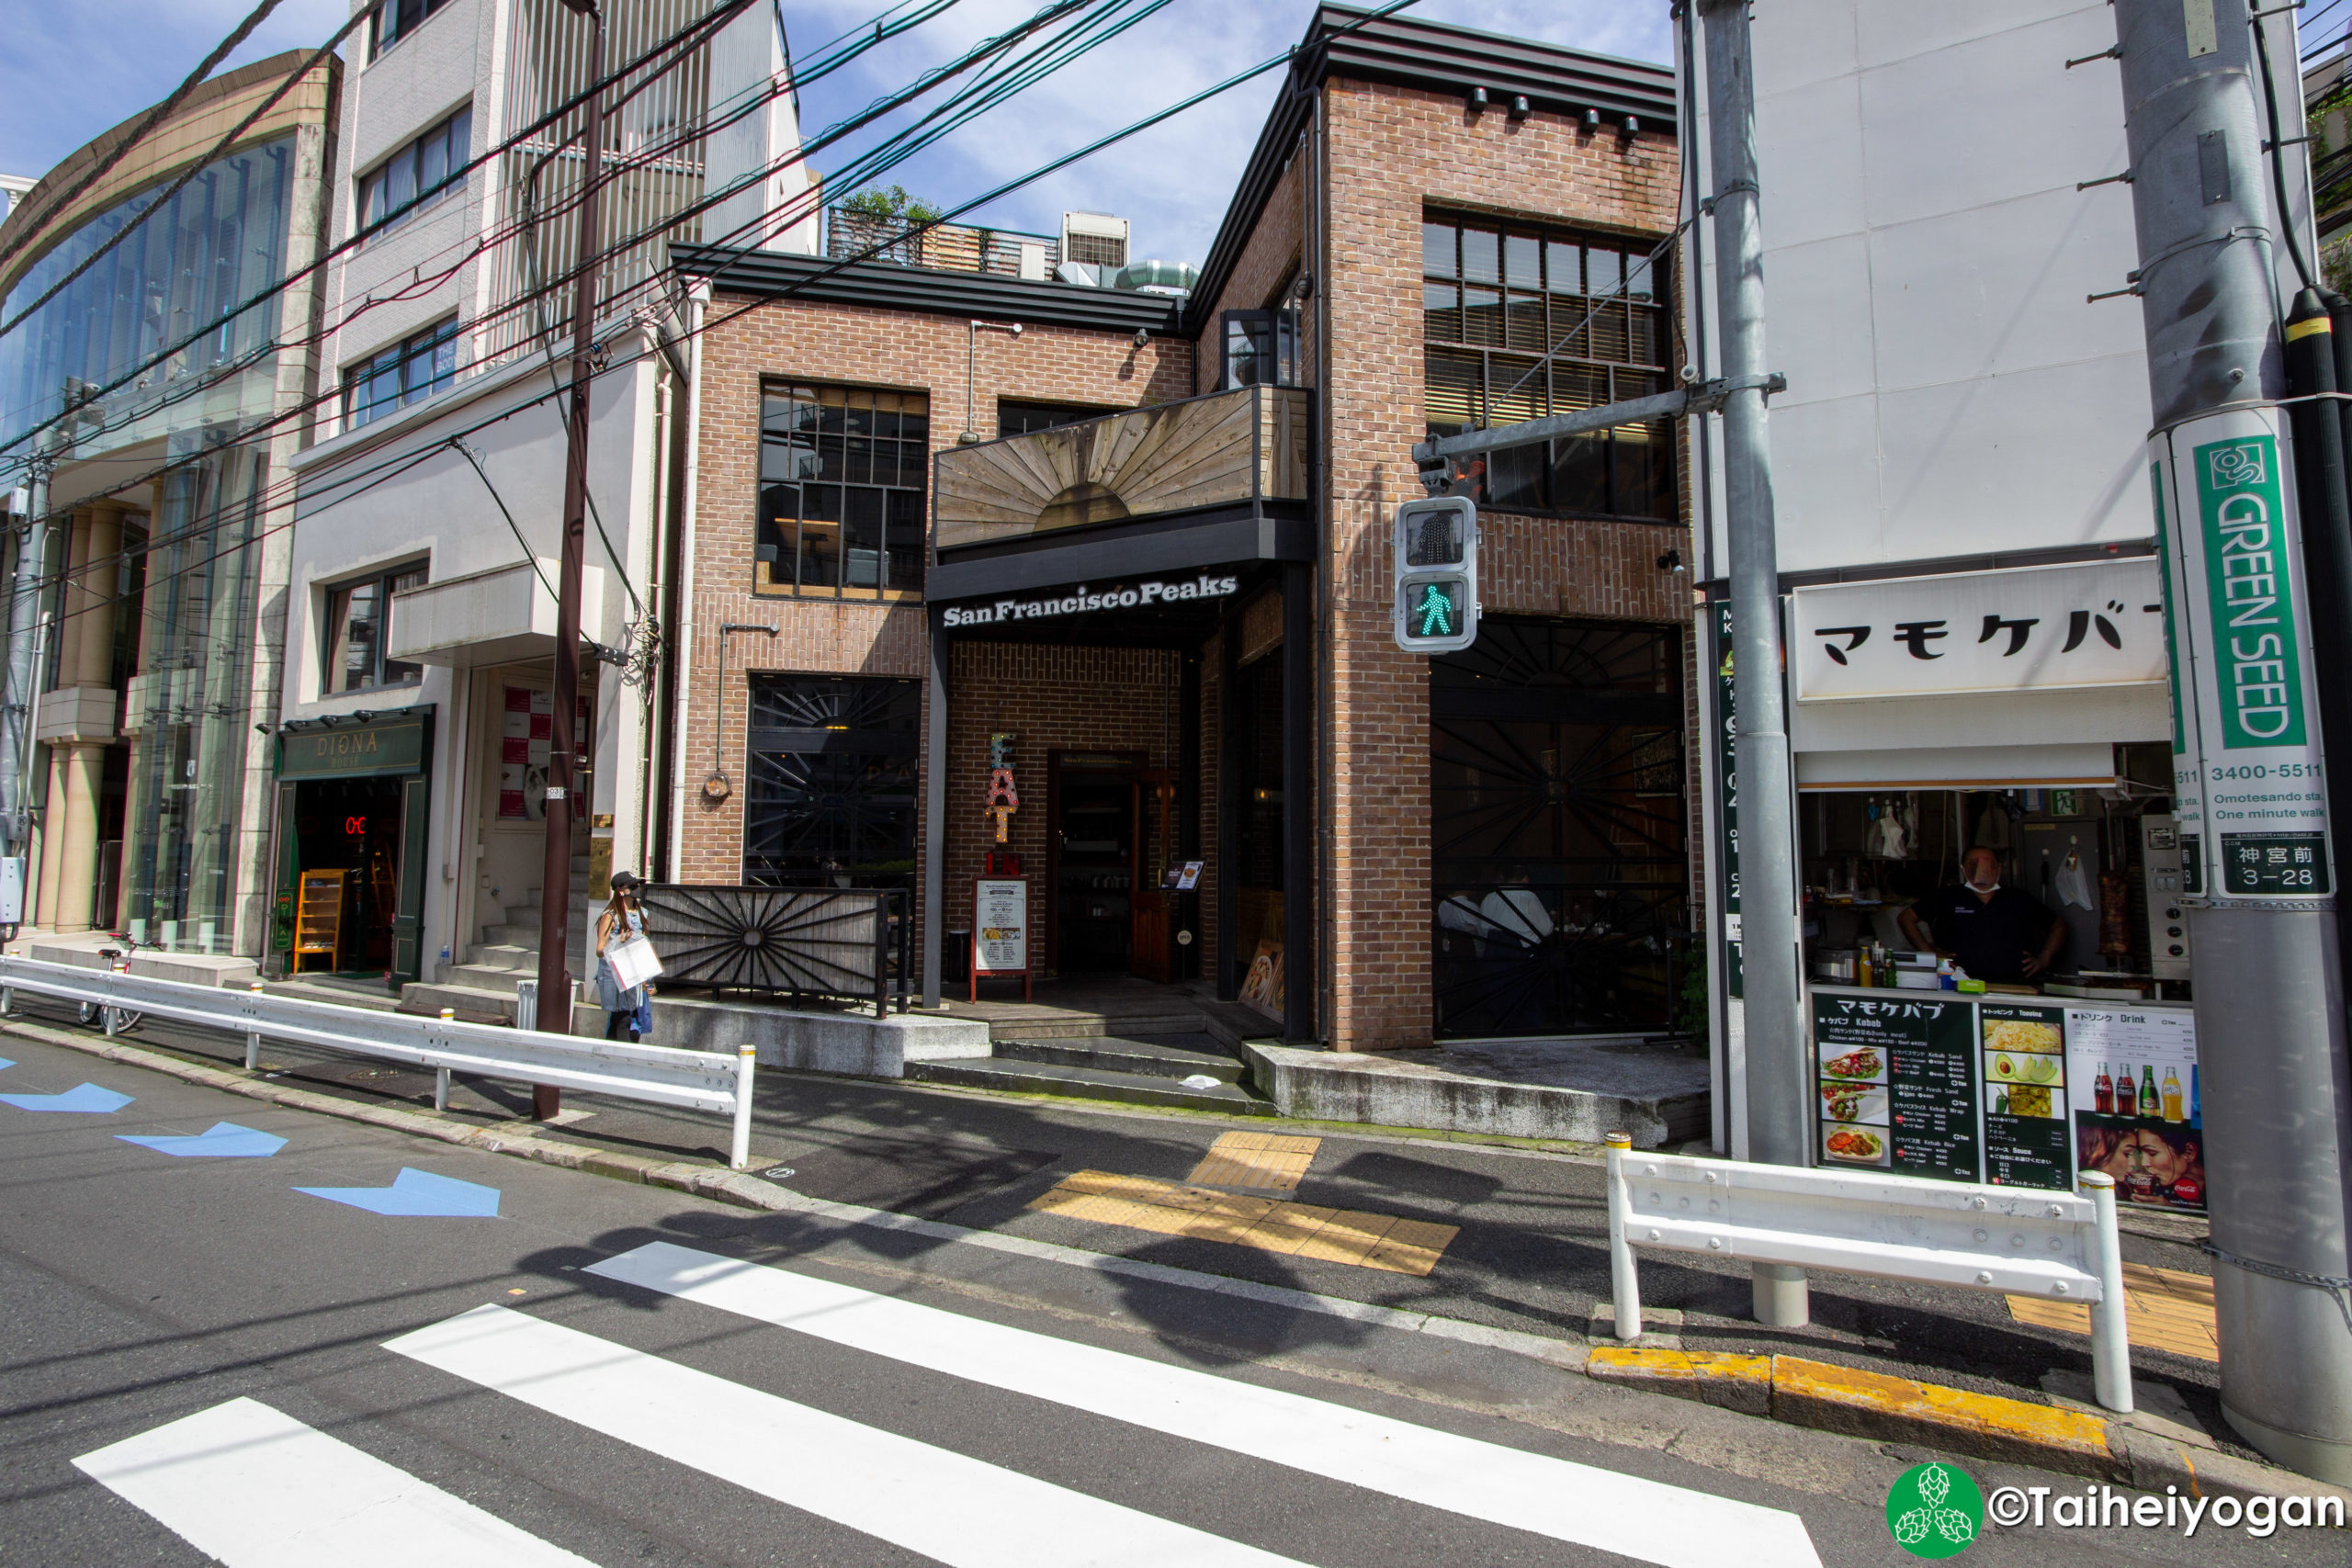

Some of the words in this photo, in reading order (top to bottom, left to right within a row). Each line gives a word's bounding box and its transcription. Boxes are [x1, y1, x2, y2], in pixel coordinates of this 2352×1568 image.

[2218, 491, 2280, 627] GREEN
[1815, 599, 2161, 666] マモケバ
[2230, 633, 2290, 738] SEED
[316, 732, 378, 757] DIONA
[2211, 763, 2322, 781] 3400-5511
[2214, 792, 2301, 804] Omotesando
[2305, 793, 2324, 801] sta.
[2216, 809, 2245, 819] One
[2248, 808, 2298, 818] minute
[2300, 807, 2325, 818] walk
[2239, 846, 2312, 863] 神宮前
[1838, 999, 1945, 1020] マモケバブ
[1856, 1018, 1882, 1028] Kebab
[2080, 1013, 2113, 1022] ドリンク
[2120, 1014, 2146, 1024] Drink
[2012, 1147, 2032, 1156] Sauce
